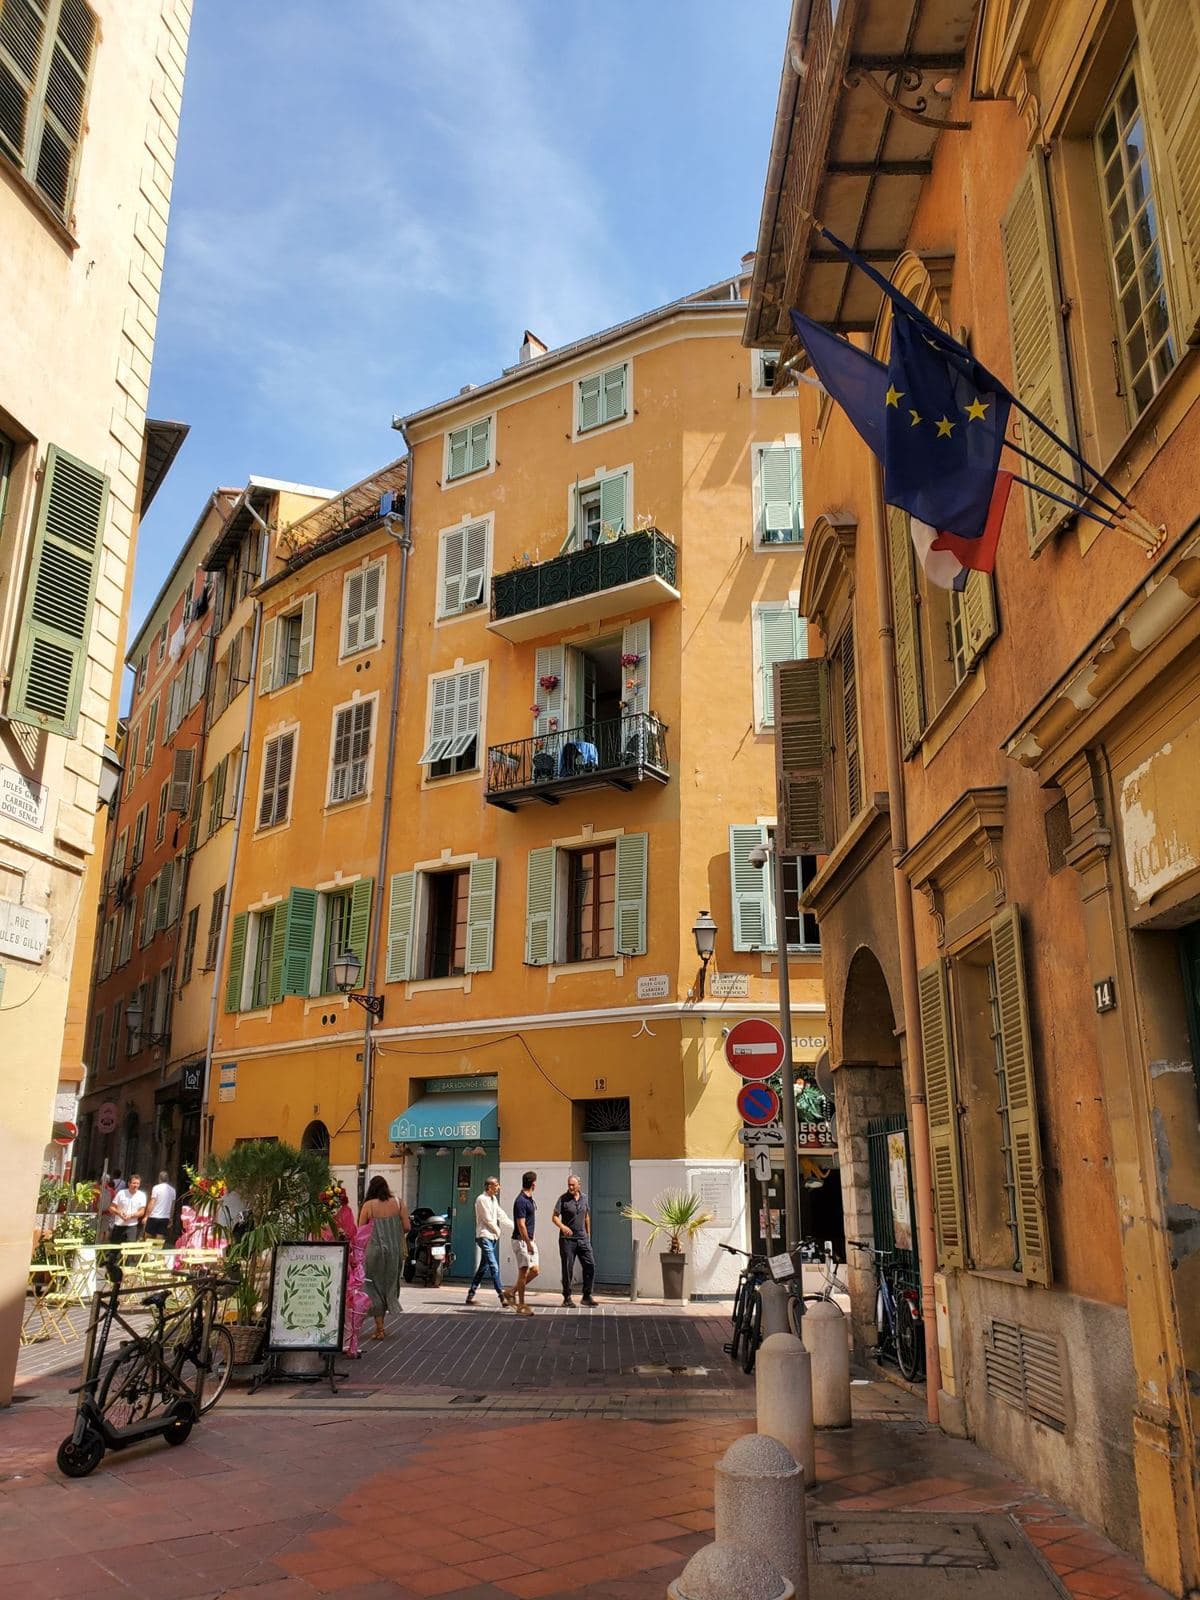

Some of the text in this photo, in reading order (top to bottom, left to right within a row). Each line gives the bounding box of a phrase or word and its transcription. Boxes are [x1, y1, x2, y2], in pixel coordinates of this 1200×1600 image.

[3, 779, 22, 794] JULES
[5, 794, 37, 814] CARRIERA
[2, 801, 39, 825] DOU SENAT
[15, 916, 30, 929] RUE
[0, 929, 43, 951] ULES GILLY
[1096, 983, 1111, 1009] 14
[595, 1078, 605, 1090] 12
[418, 1125, 477, 1138] LES VOUTES
